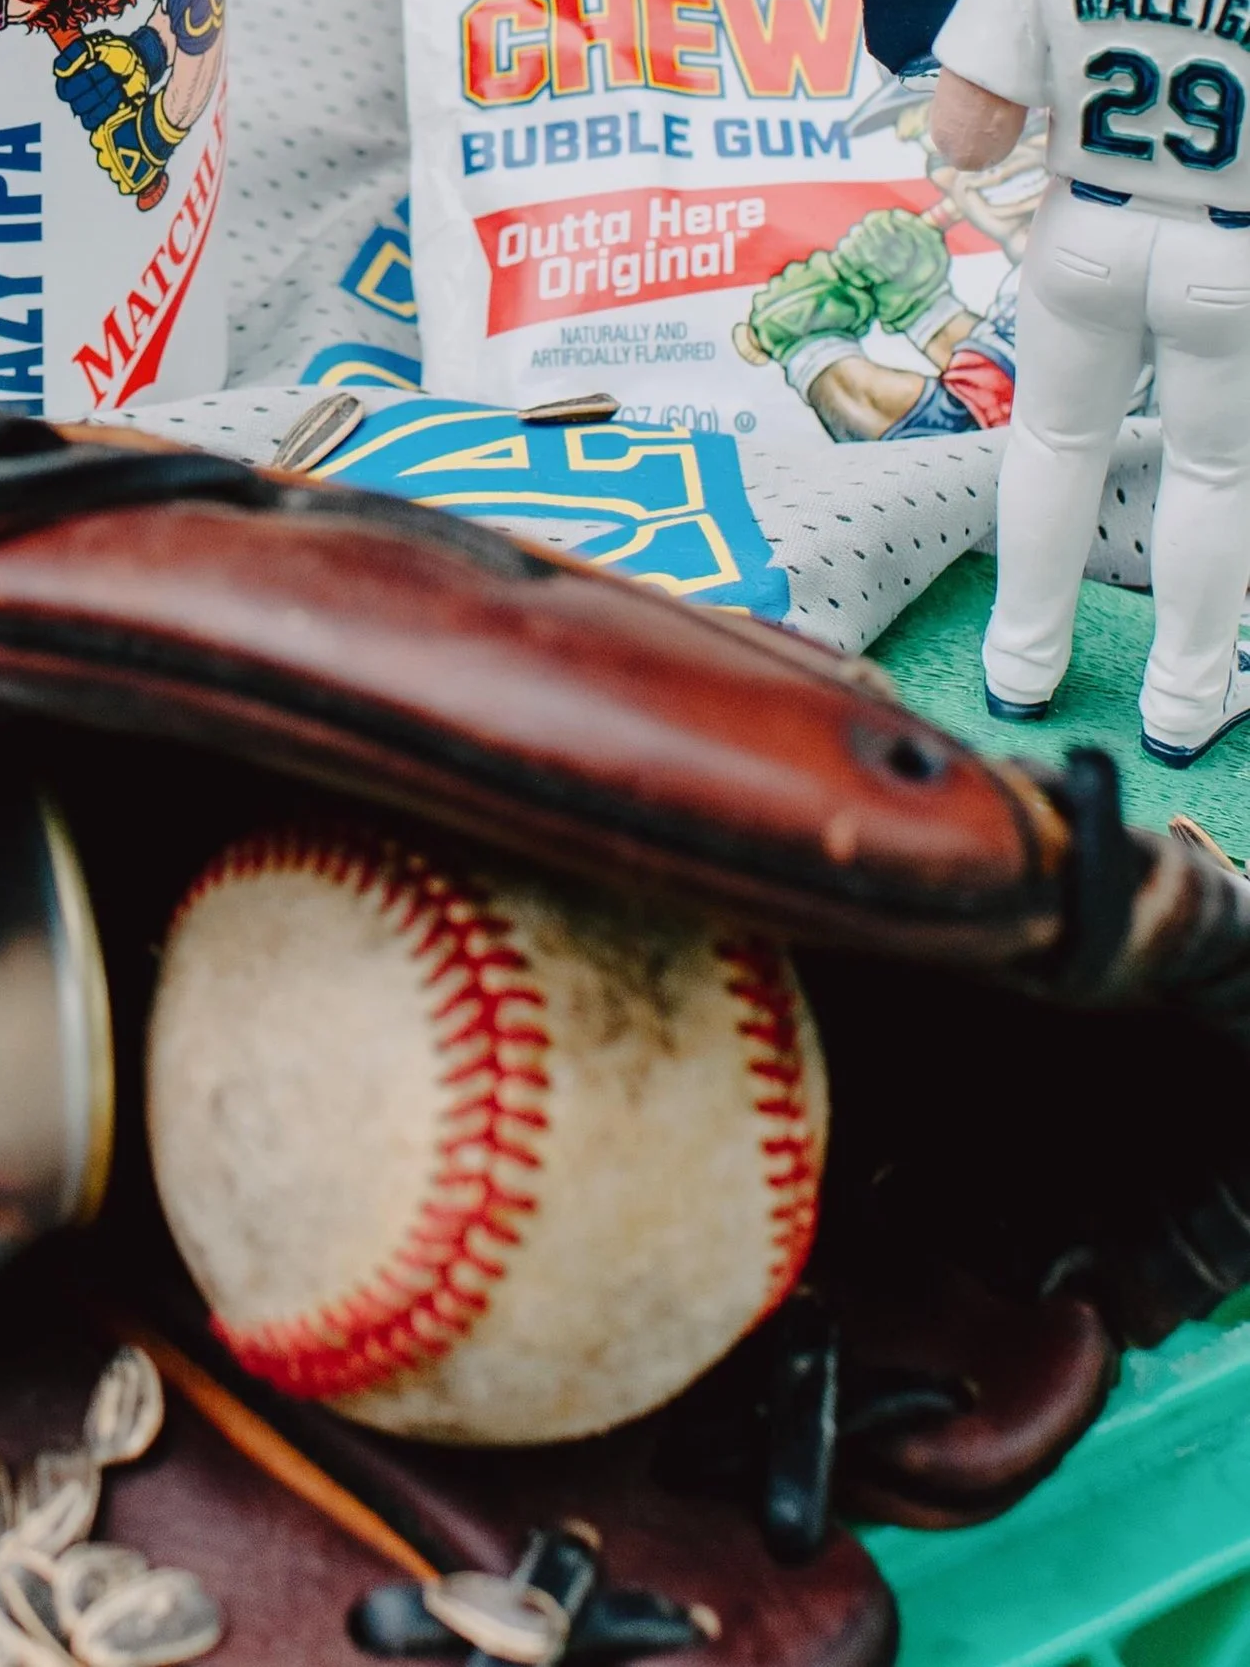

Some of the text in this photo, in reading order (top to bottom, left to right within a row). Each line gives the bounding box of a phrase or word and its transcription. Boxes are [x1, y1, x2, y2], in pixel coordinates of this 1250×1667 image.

[1081, 46, 1246, 172] 29
[461, 111, 852, 176] BUBBLE GUM
[496, 195, 767, 269] Outta Here
[537, 230, 737, 302] Original
[530, 341, 717, 369] ARTIFICIALLY FLAVORED
[560, 321, 689, 346] NATURALLY AND
